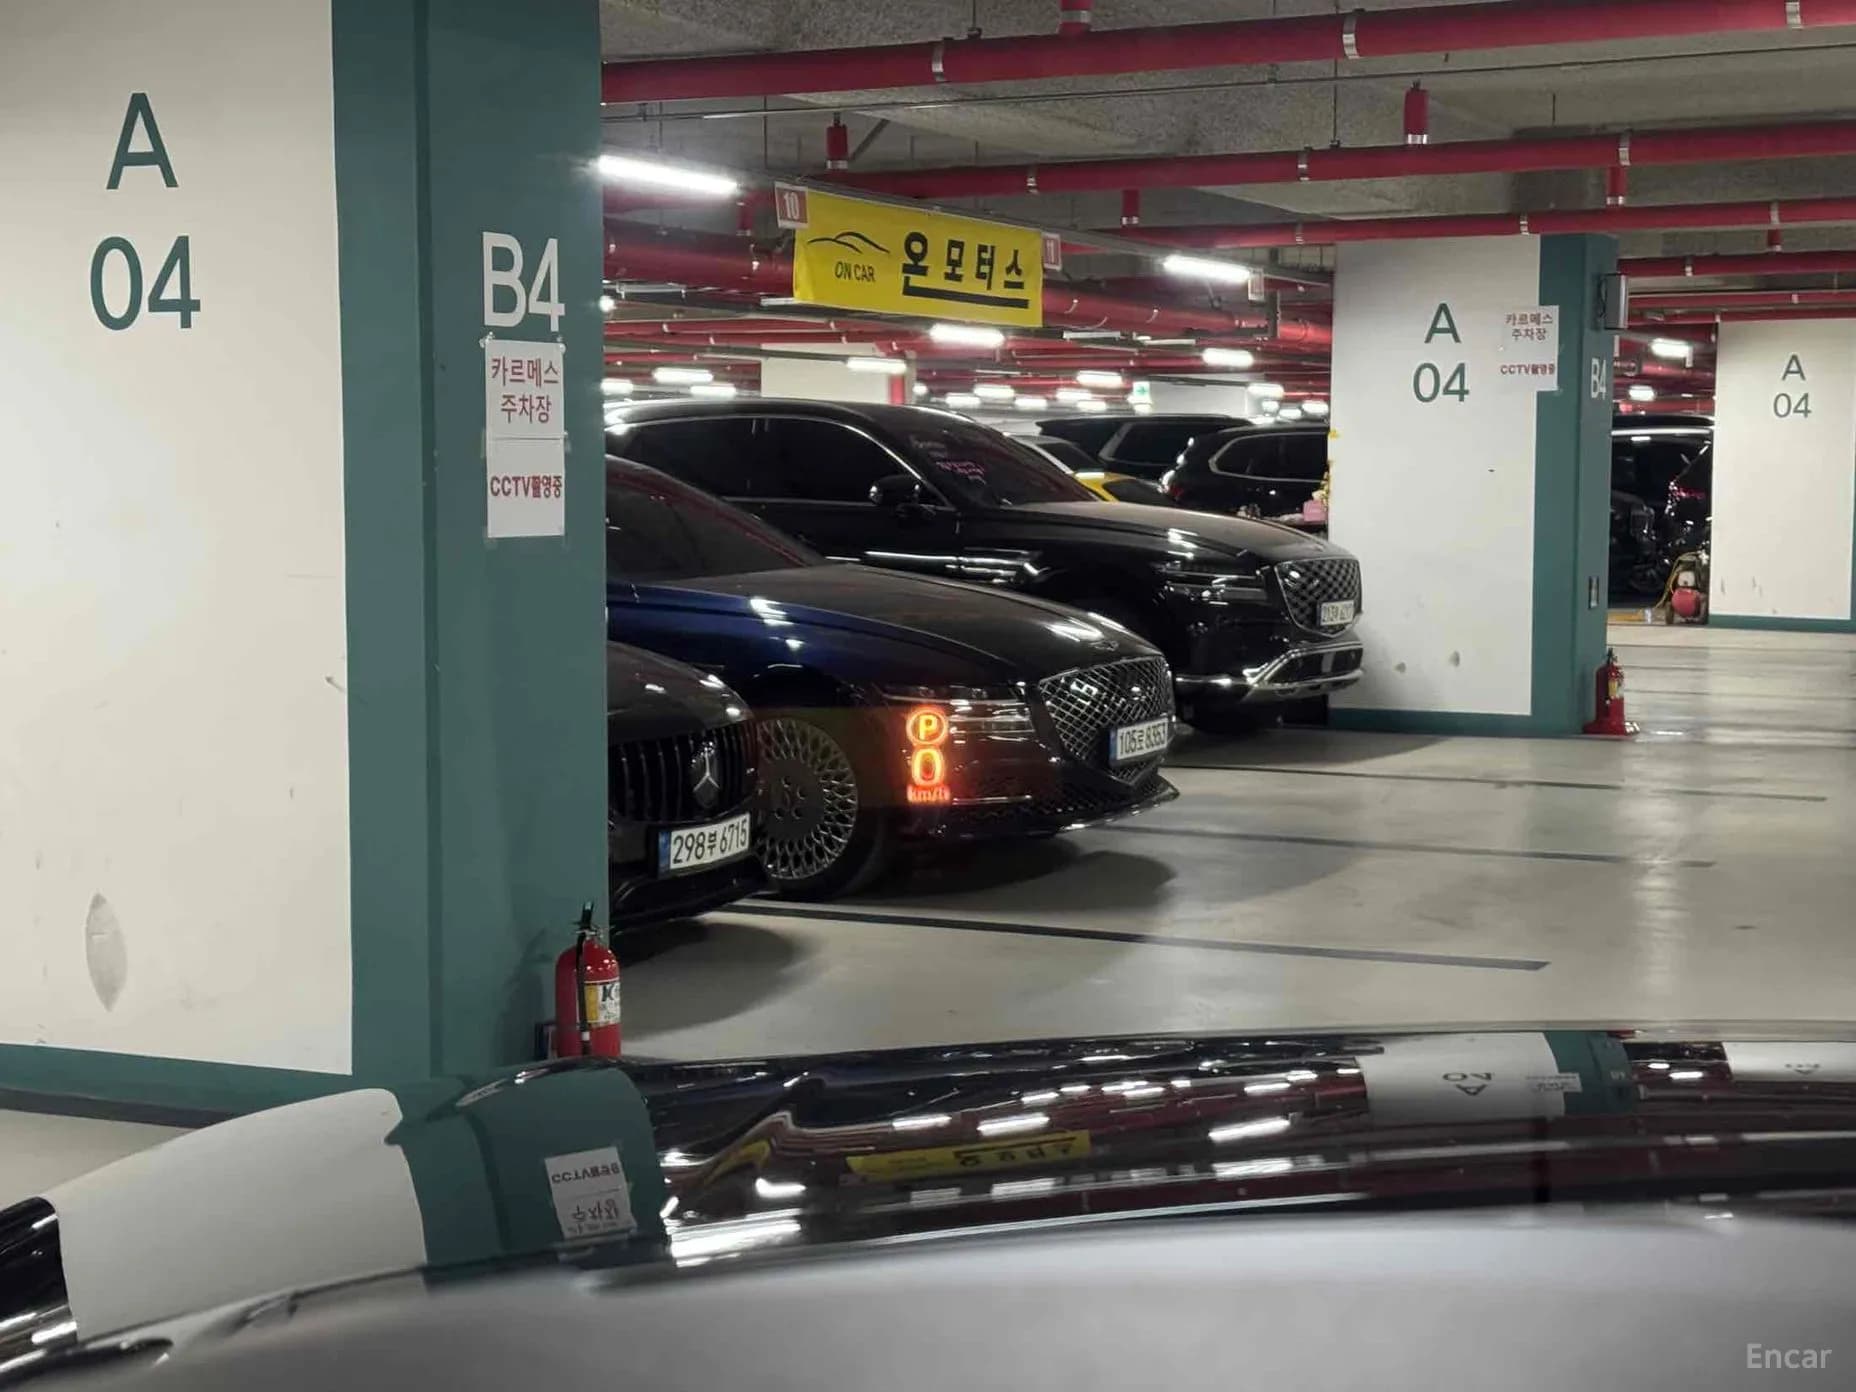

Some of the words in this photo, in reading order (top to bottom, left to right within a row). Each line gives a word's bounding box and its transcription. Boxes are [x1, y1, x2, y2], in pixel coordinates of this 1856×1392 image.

[106, 92, 179, 190] A
[784, 191, 800, 220] 10
[90, 235, 201, 331] 04
[482, 231, 566, 332] B4
[835, 261, 851, 281] ON
[853, 262, 876, 283] CAR
[1424, 303, 1462, 344] A
[491, 356, 560, 387] 카르메스
[1413, 362, 1470, 402] 04
[1591, 357, 1607, 400] B4
[1781, 354, 1806, 381] A
[500, 394, 552, 424] 주차장
[1773, 393, 1812, 418] 04
[919, 714, 938, 741] P
[911, 748, 945, 787] 0
